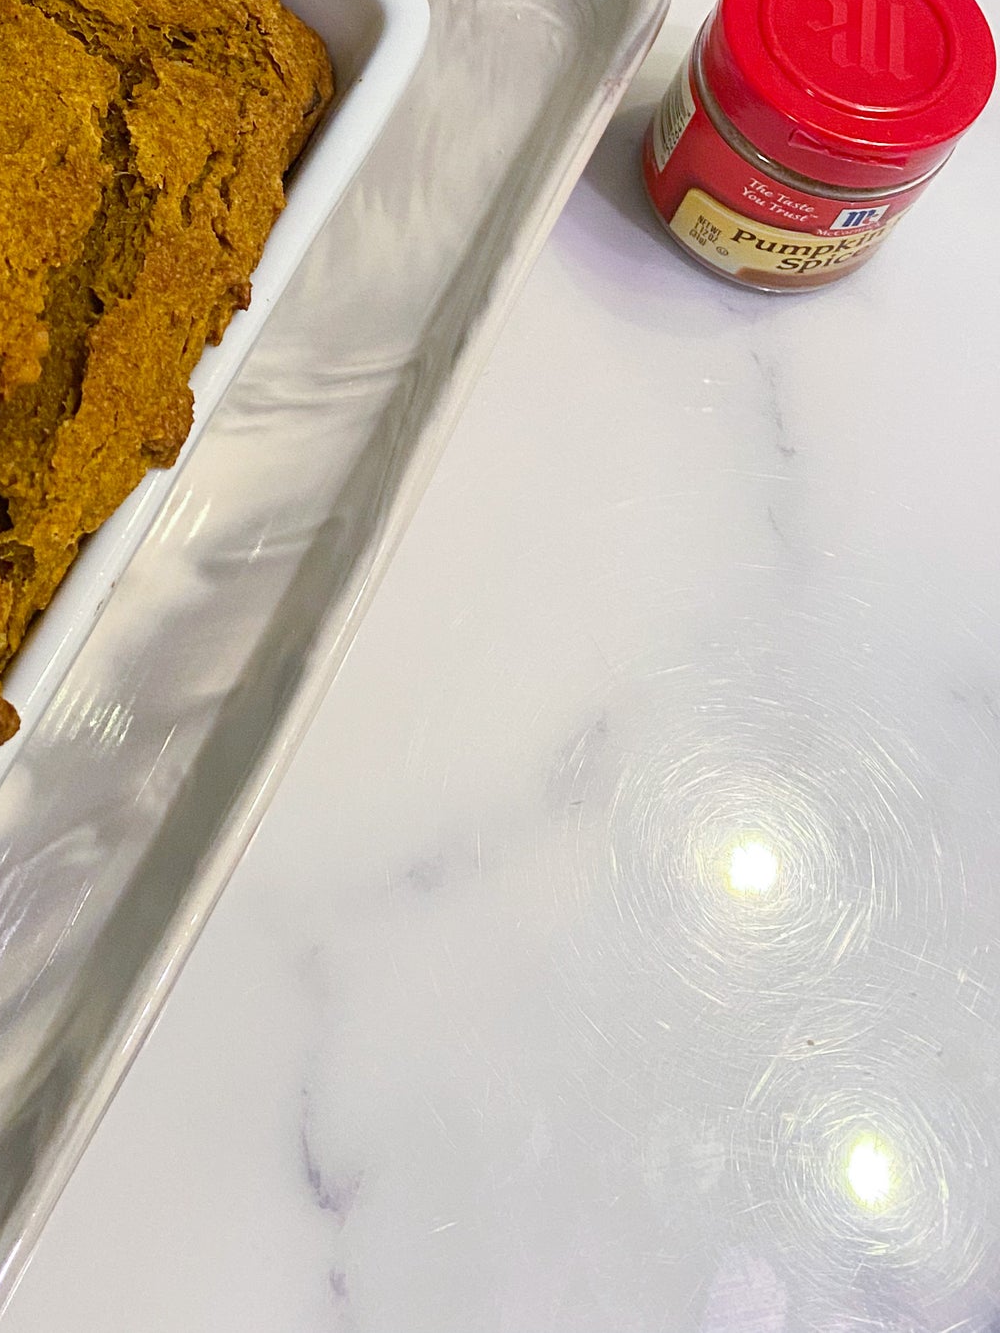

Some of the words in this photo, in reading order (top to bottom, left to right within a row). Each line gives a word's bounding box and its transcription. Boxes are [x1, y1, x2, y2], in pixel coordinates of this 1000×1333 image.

[742, 187, 764, 206] You
[768, 202, 811, 222] Trust
[750, 177, 772, 198] The
[777, 192, 815, 214] Taste
[709, 224, 721, 237] WT
[729, 227, 886, 261] Pumpkin
